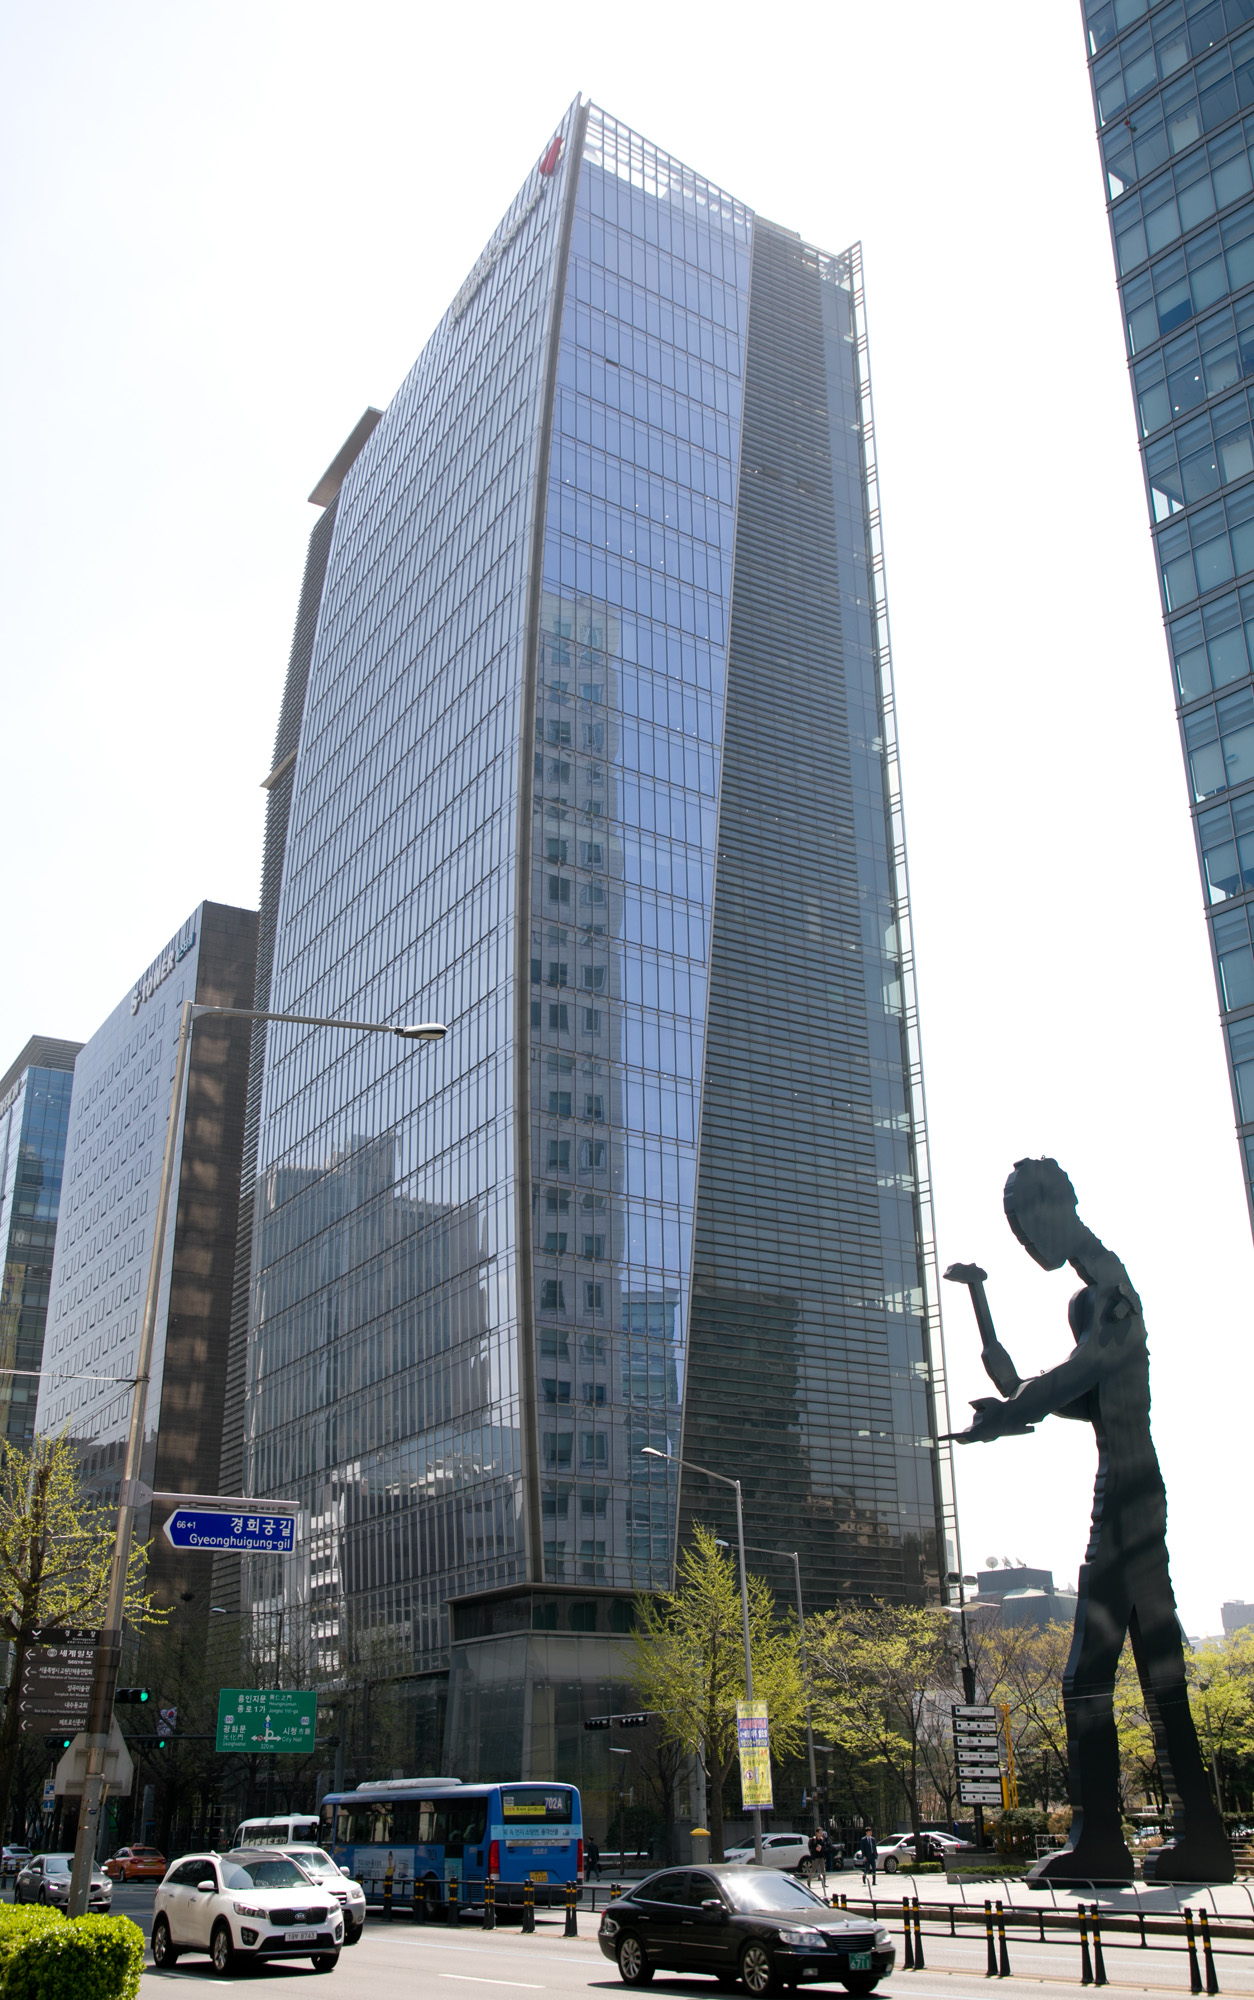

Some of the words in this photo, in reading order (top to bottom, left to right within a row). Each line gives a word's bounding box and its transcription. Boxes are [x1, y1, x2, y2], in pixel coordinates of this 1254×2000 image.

[230, 1517, 292, 1537] 경희궁길
[189, 1533, 291, 1551] Gyeonghuigung-gil
[59, 1649, 93, 1658] 세계일보
[38, 1666, 59, 1674] 서울특별시
[237, 1694, 266, 1704] 흥인지문
[64, 1701, 88, 1710] 내수동교회
[223, 1725, 246, 1734] 광화문
[282, 1727, 296, 1736] 시청
[544, 1797, 563, 1810] 702A
[850, 1959, 870, 1970] 6711
